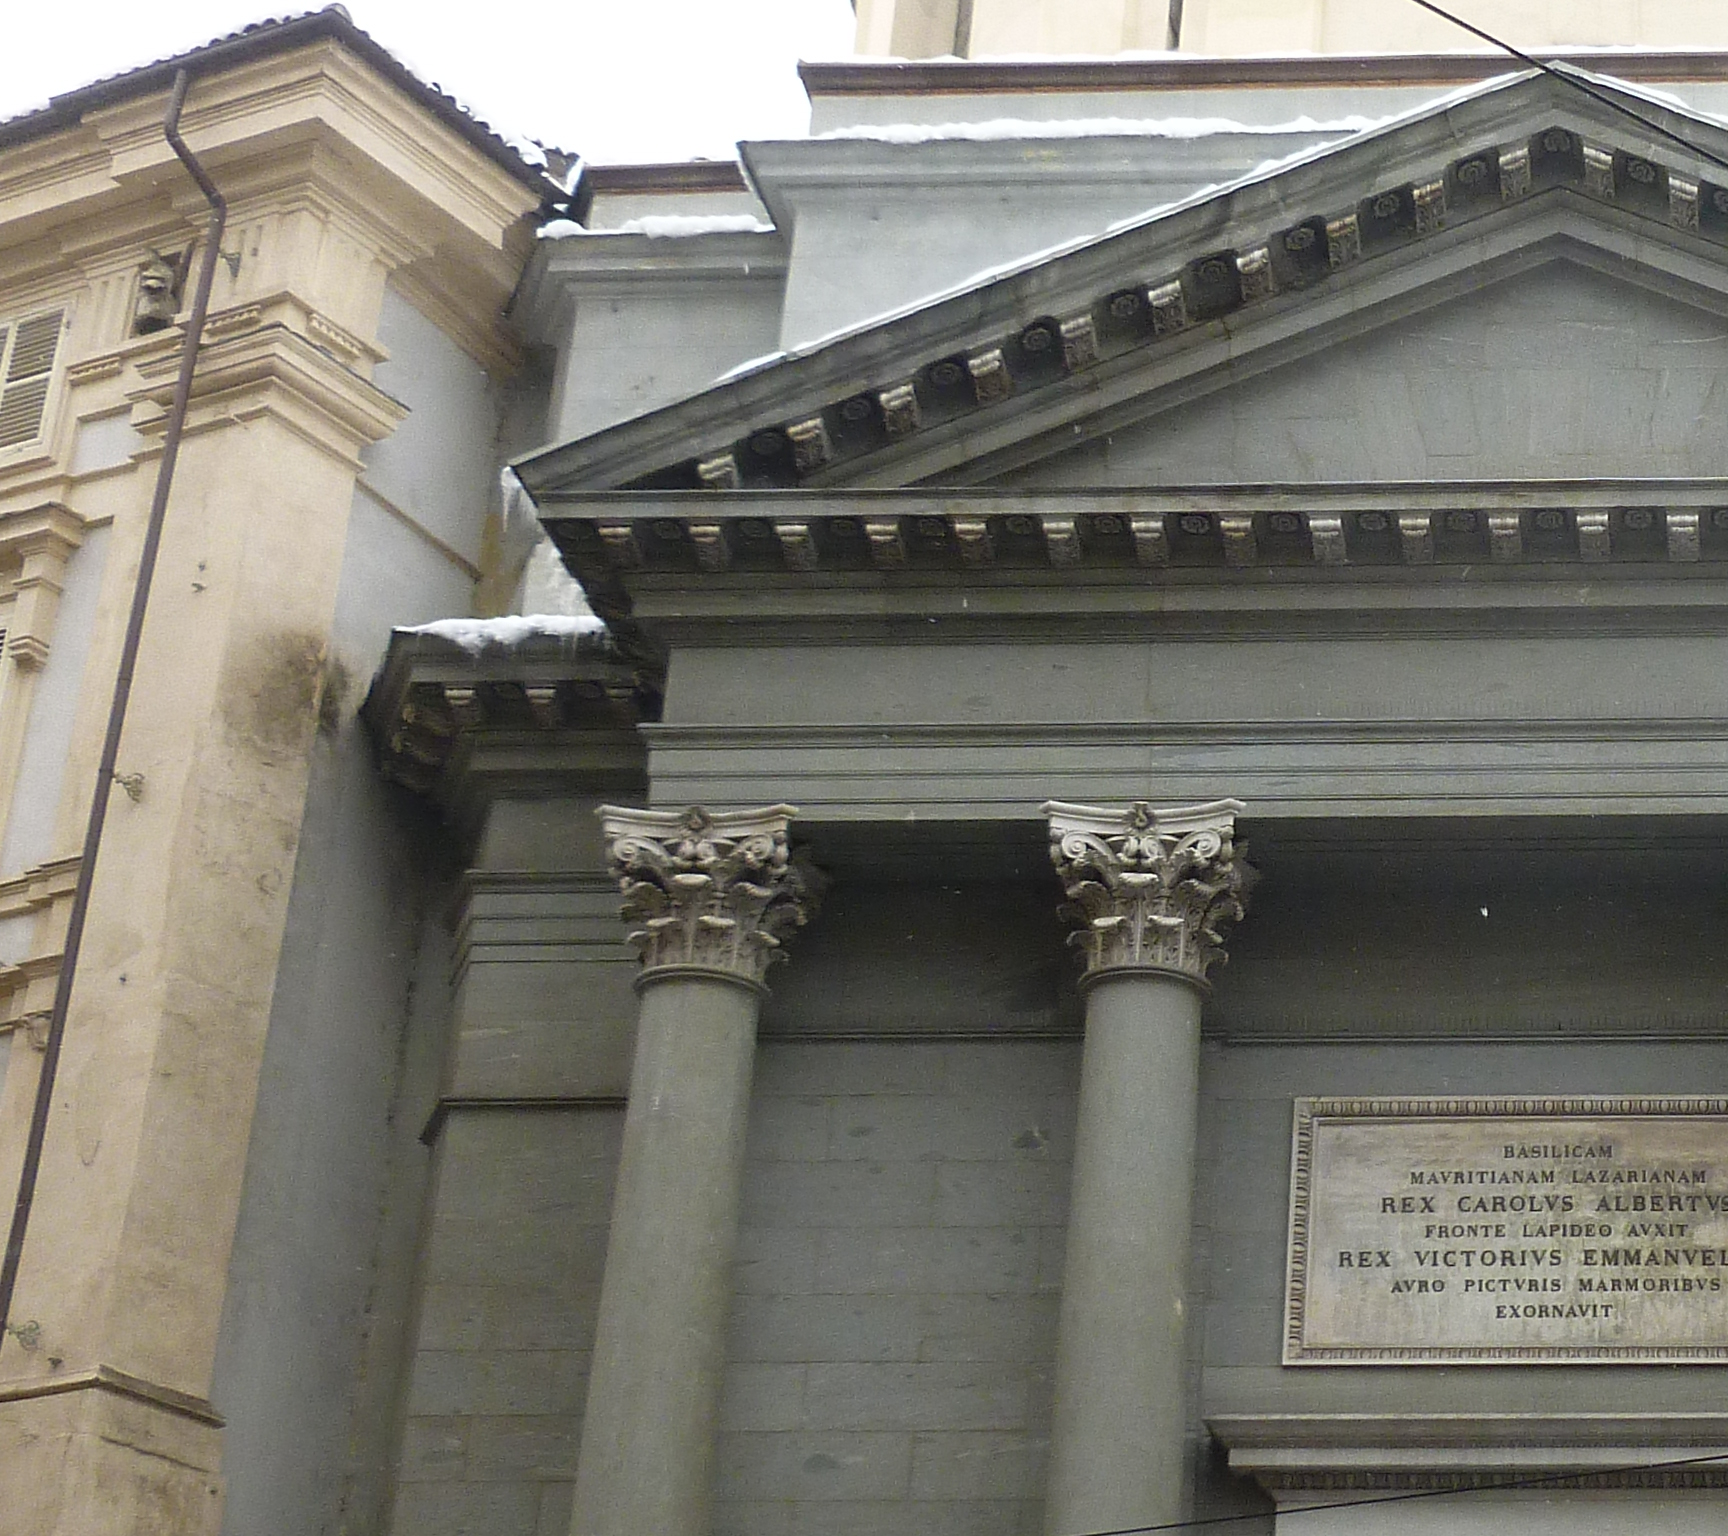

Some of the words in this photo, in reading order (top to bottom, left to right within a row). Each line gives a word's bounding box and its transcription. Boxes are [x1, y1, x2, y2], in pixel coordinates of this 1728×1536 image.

[1502, 1144, 1614, 1160] BASILICAM
[1409, 1169, 1556, 1186] MAVRITIANAM
[1571, 1169, 1707, 1185] LAZARIANAM
[1380, 1196, 1437, 1214] REX
[1456, 1194, 1575, 1214] CAROLVS
[1424, 1224, 1507, 1239] FRONTE
[1522, 1223, 1613, 1239] LAPIDEO
[1626, 1222, 1690, 1238] AVXIT
[1337, 1249, 1392, 1269] REX
[1413, 1248, 1563, 1268] VICTORIVS
[1390, 1279, 1446, 1294] AVRO
[1463, 1277, 1563, 1293] PICTVRIS
[1577, 1277, 1722, 1293] MARMORIBVS
[1494, 1303, 1614, 1320] EXORNAVIT
